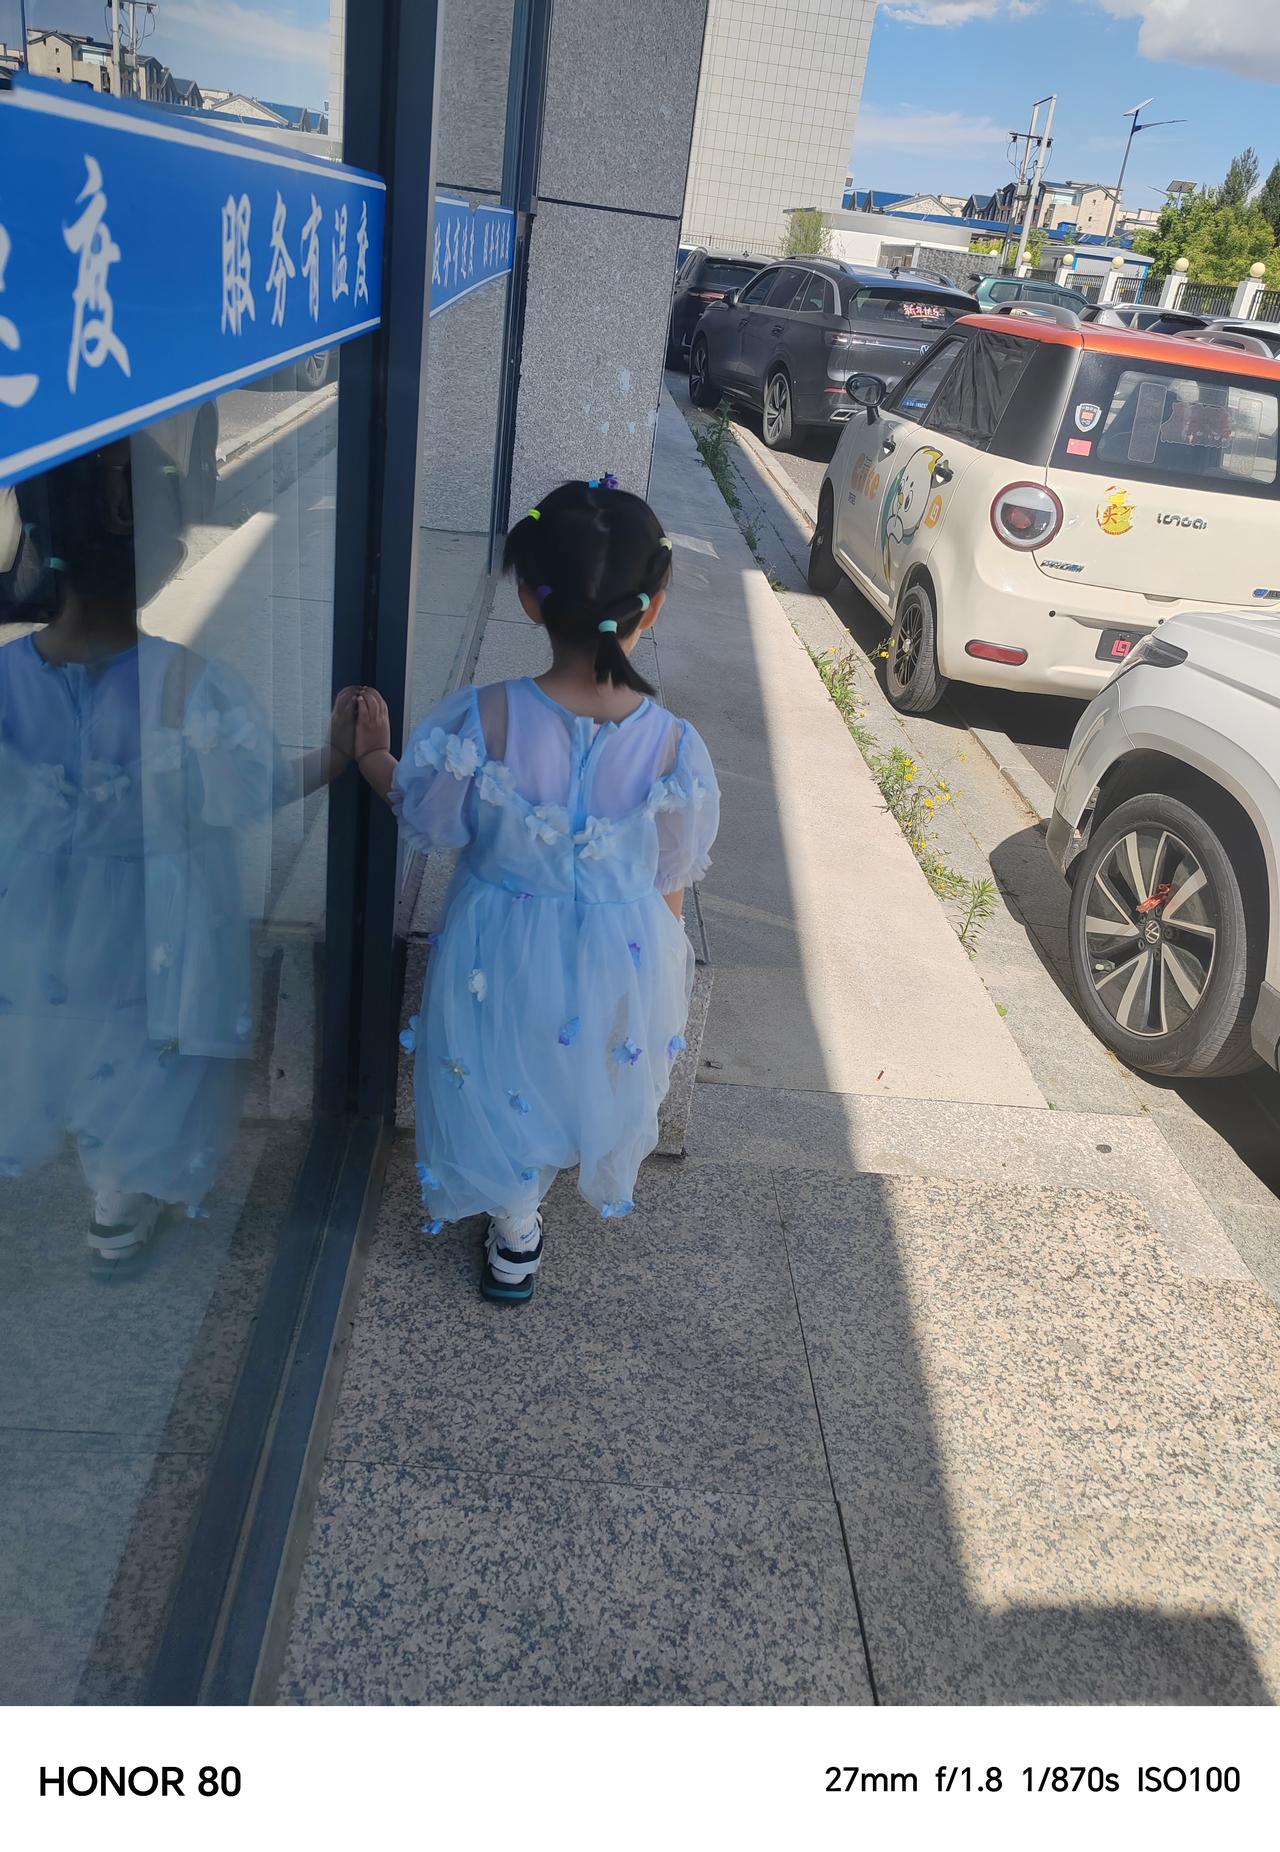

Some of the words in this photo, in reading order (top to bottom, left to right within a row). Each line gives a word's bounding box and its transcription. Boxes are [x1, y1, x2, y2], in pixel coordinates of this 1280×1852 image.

[221, 190, 370, 336] 服务有温度
